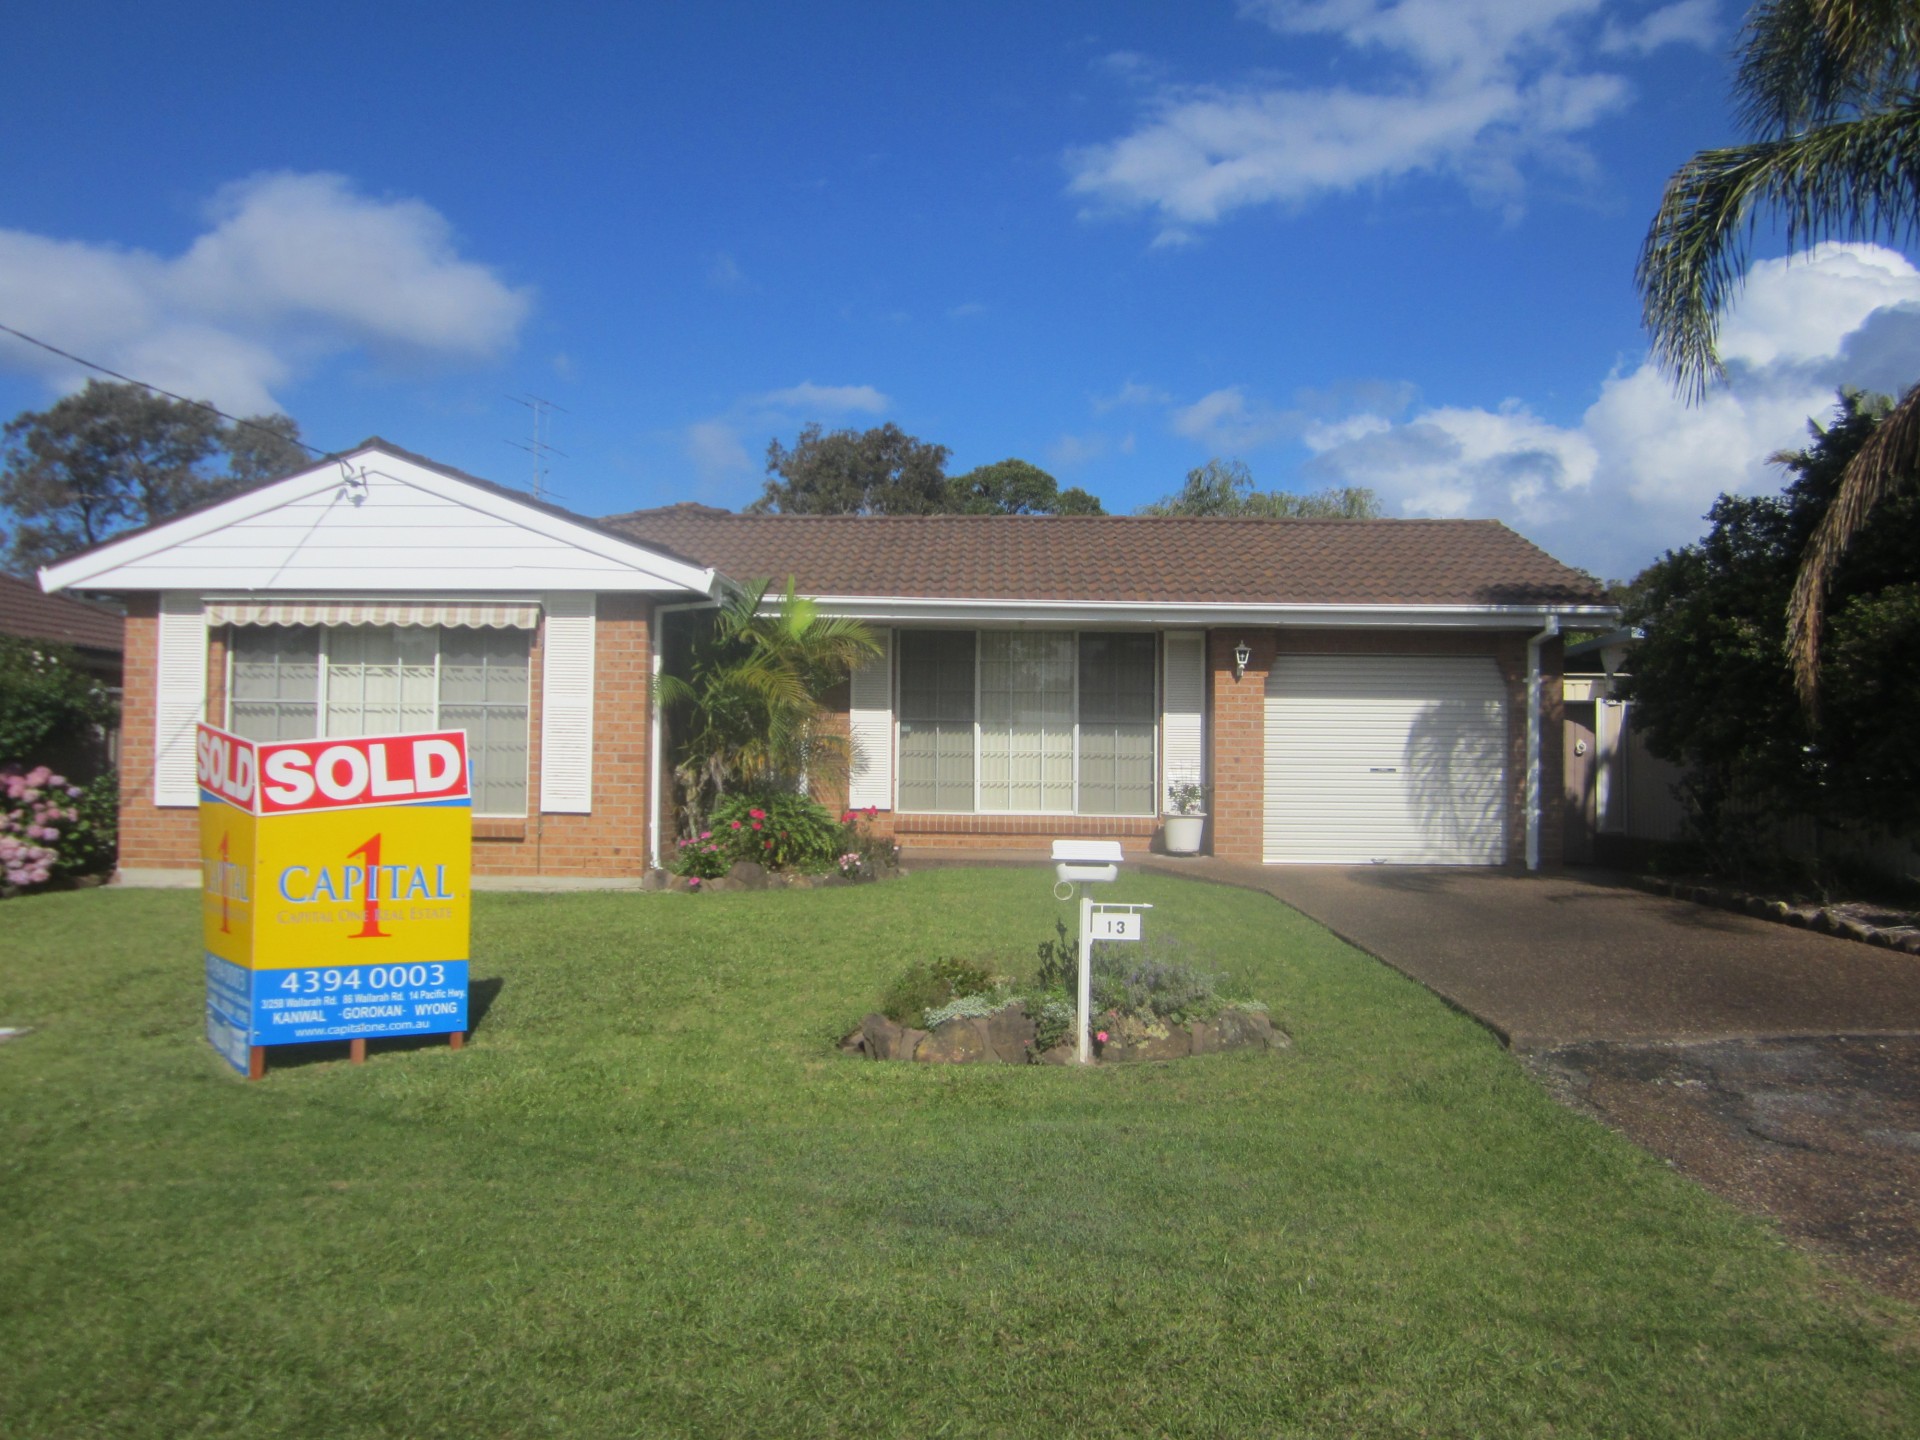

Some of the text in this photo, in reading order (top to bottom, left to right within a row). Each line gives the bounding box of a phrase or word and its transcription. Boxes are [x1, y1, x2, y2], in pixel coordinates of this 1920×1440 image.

[197, 730, 253, 801] SOLD
[265, 739, 461, 805] SOLD
[278, 864, 454, 903] CAPITAL
[346, 832, 392, 939] 1
[276, 906, 453, 925] CAPITAL ONE REAL ESTATE
[1107, 920, 1126, 935] 13
[280, 969, 362, 994] 4394
[368, 964, 446, 990] 0003
[409, 990, 419, 1000] 14
[420, 989, 447, 1000] Pacific
[272, 1010, 327, 1025] KANWAL
[415, 1002, 458, 1016] WYONG
[295, 1020, 430, 1037] www.capitalone.com.au
